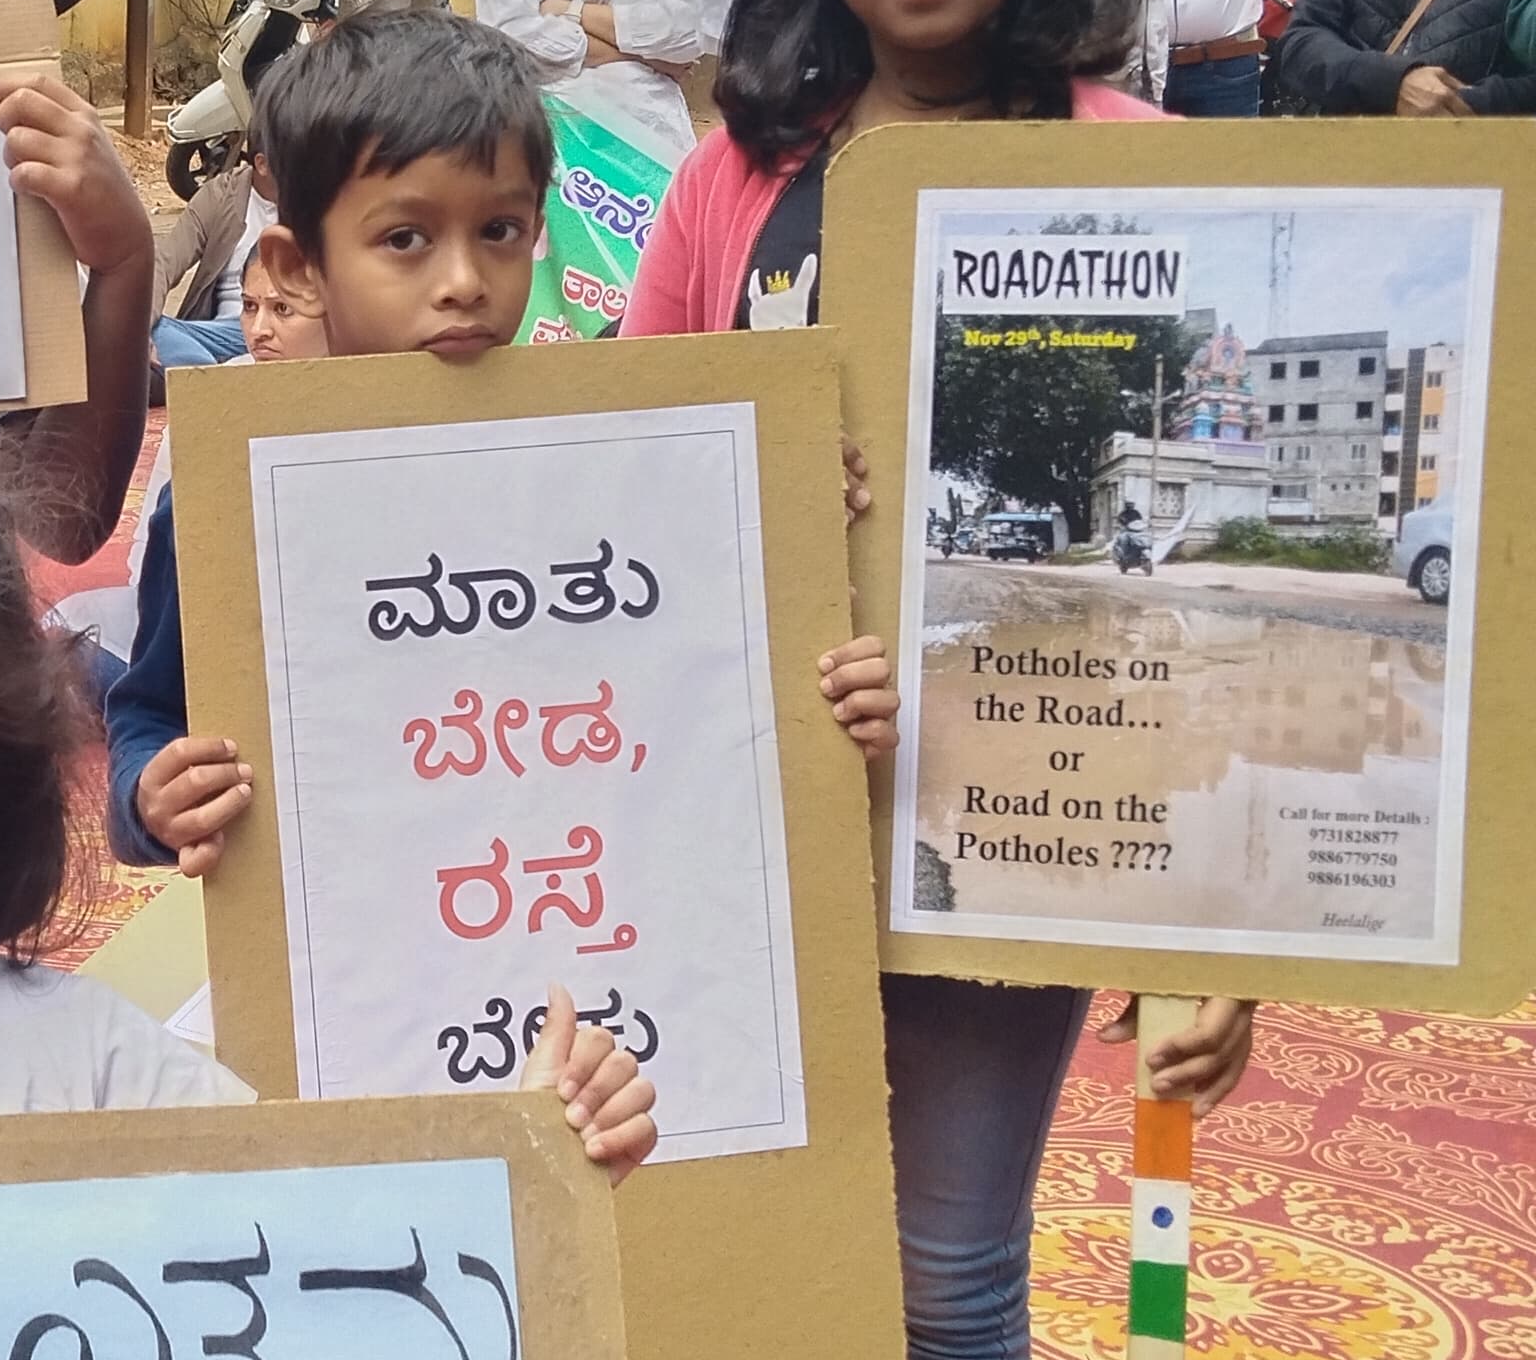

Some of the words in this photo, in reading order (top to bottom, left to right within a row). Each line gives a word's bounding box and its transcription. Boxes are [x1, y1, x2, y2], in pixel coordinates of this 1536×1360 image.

[953, 248, 1181, 300] ROADATHON
[964, 328, 1002, 347] Nov
[1049, 329, 1137, 351] Saturday
[365, 538, 661, 643] ಮಾತು
[971, 645, 1118, 683] Potholes
[1128, 659, 1171, 684] on
[403, 680, 648, 781] ಬೇಡ,
[975, 694, 1026, 725] the
[1036, 696, 1163, 731] Road...
[1050, 750, 1086, 773] or
[964, 784, 1051, 819] Road
[1062, 798, 1105, 823] on
[1114, 794, 1169, 825] the
[1279, 807, 1308, 821] Call
[1311, 807, 1332, 821] for
[1335, 810, 1371, 823] more
[1375, 809, 1421, 825] Details
[952, 831, 1100, 870] Potholes
[1110, 840, 1173, 874] ????
[437, 825, 639, 956] ರಸ್ತೆ
